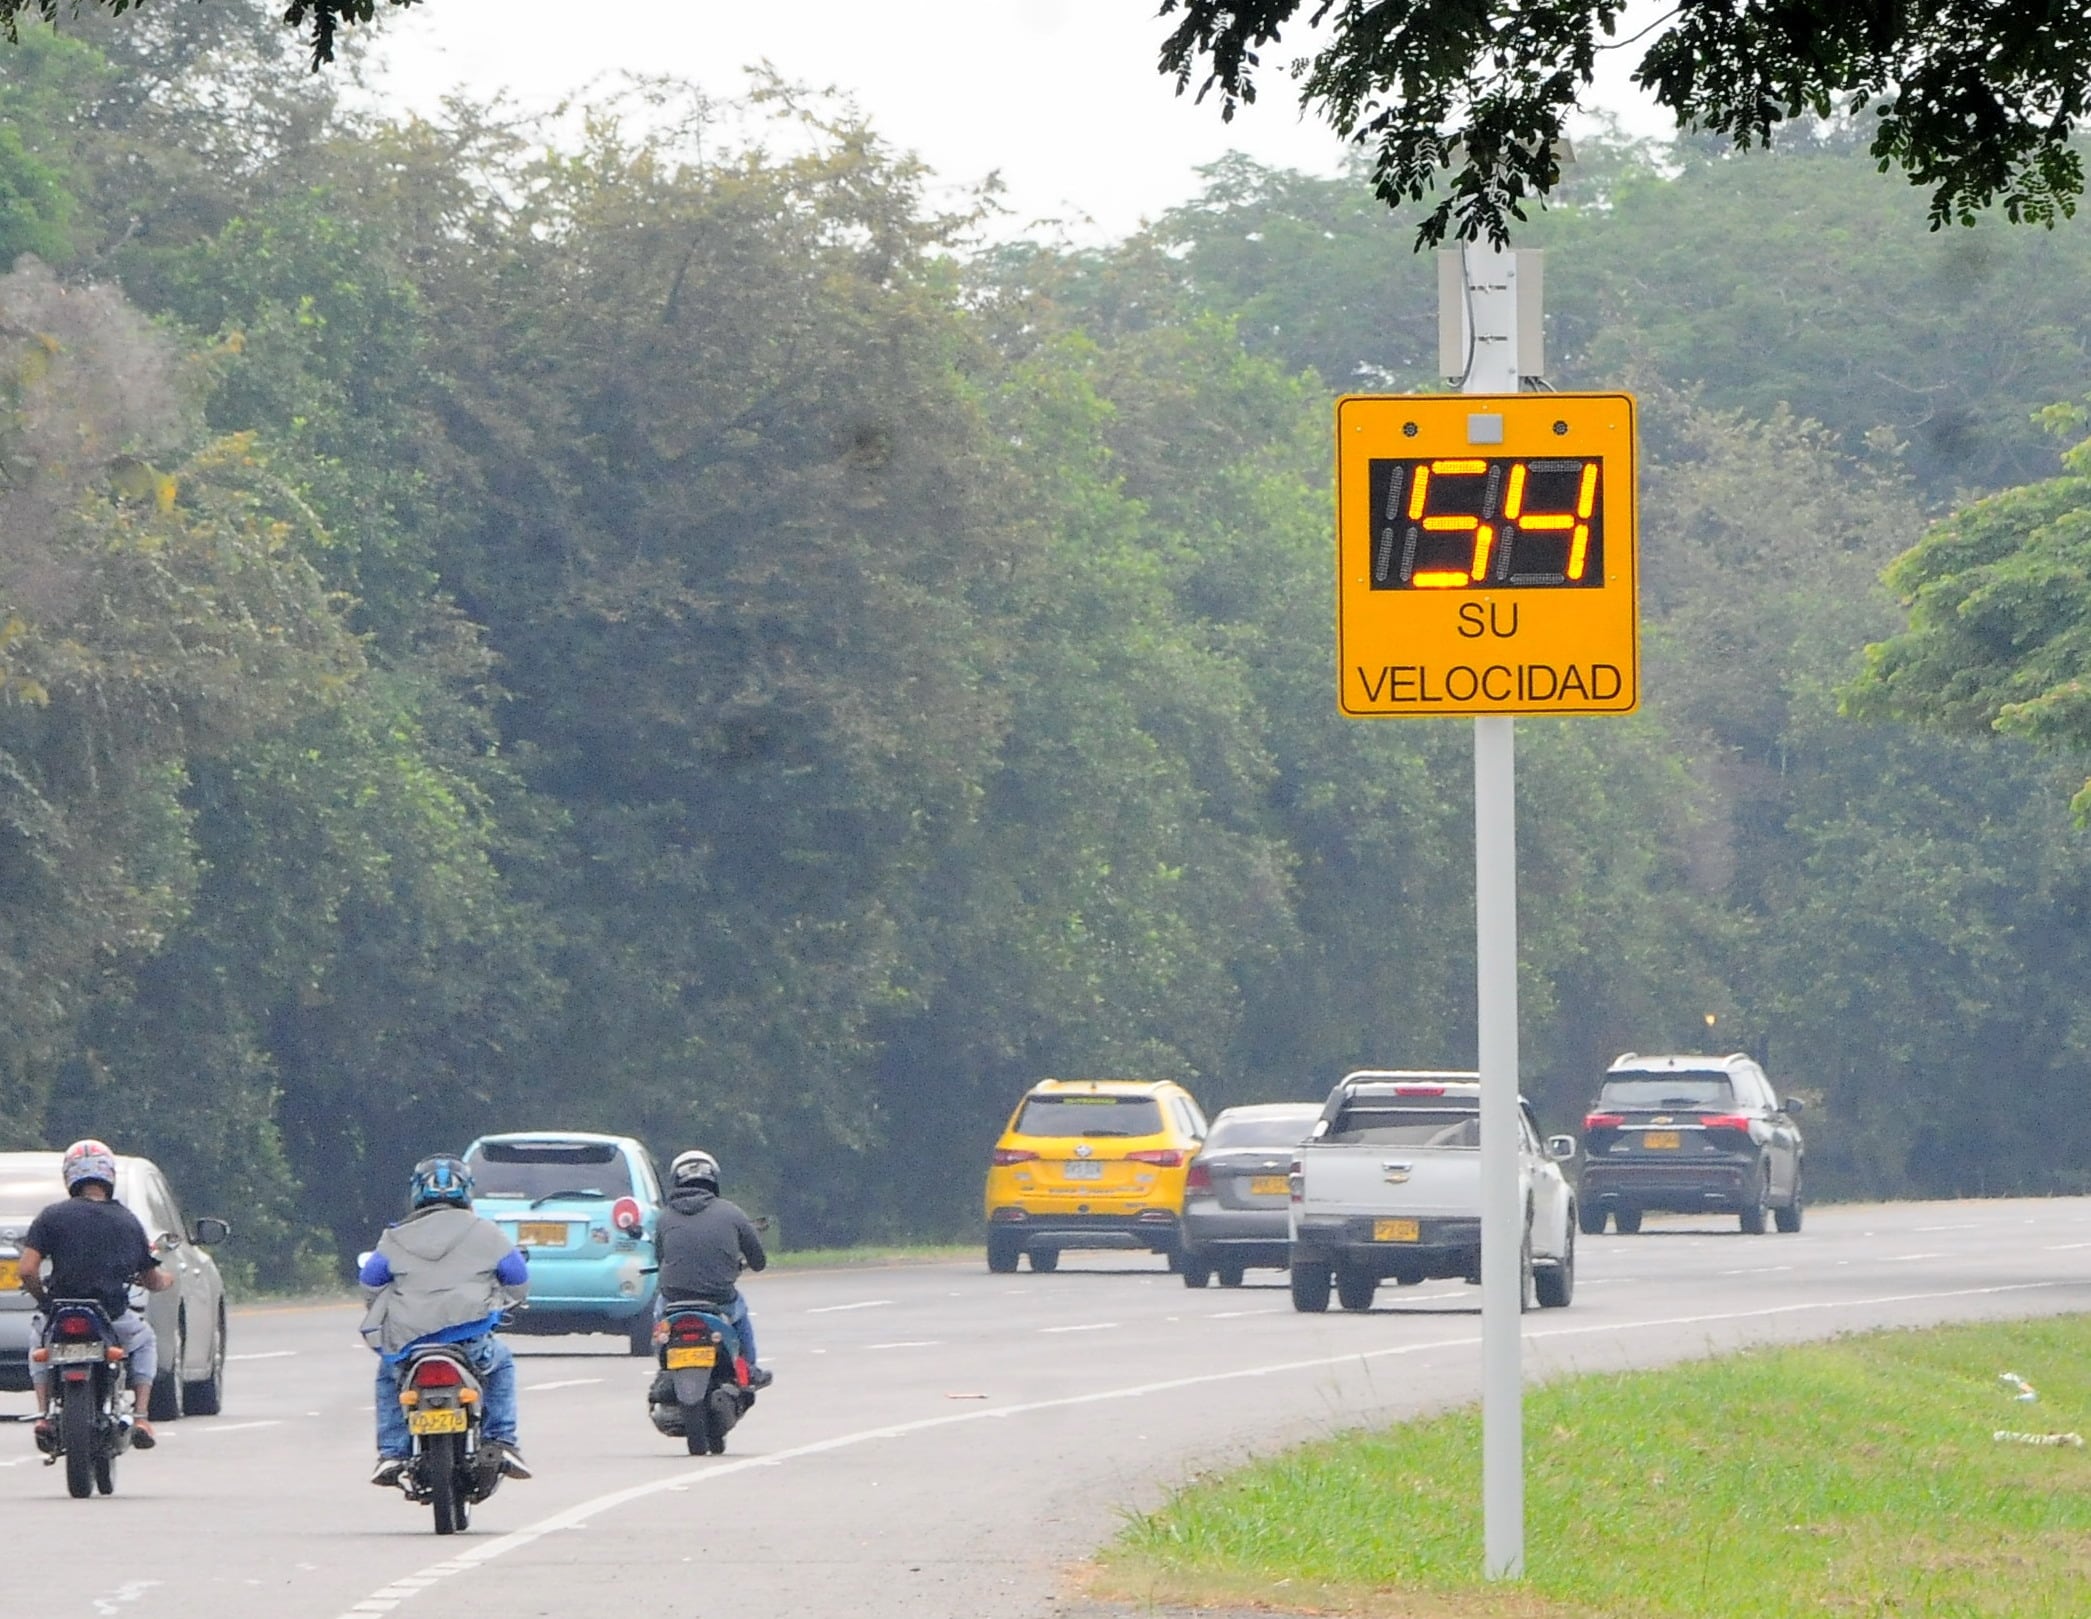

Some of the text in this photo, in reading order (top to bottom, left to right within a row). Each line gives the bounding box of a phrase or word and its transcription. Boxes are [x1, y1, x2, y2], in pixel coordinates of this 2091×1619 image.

[1408, 459, 1598, 588] 54
[1457, 602, 1518, 638] SU
[1357, 664, 1622, 702] VELOCIDAD
